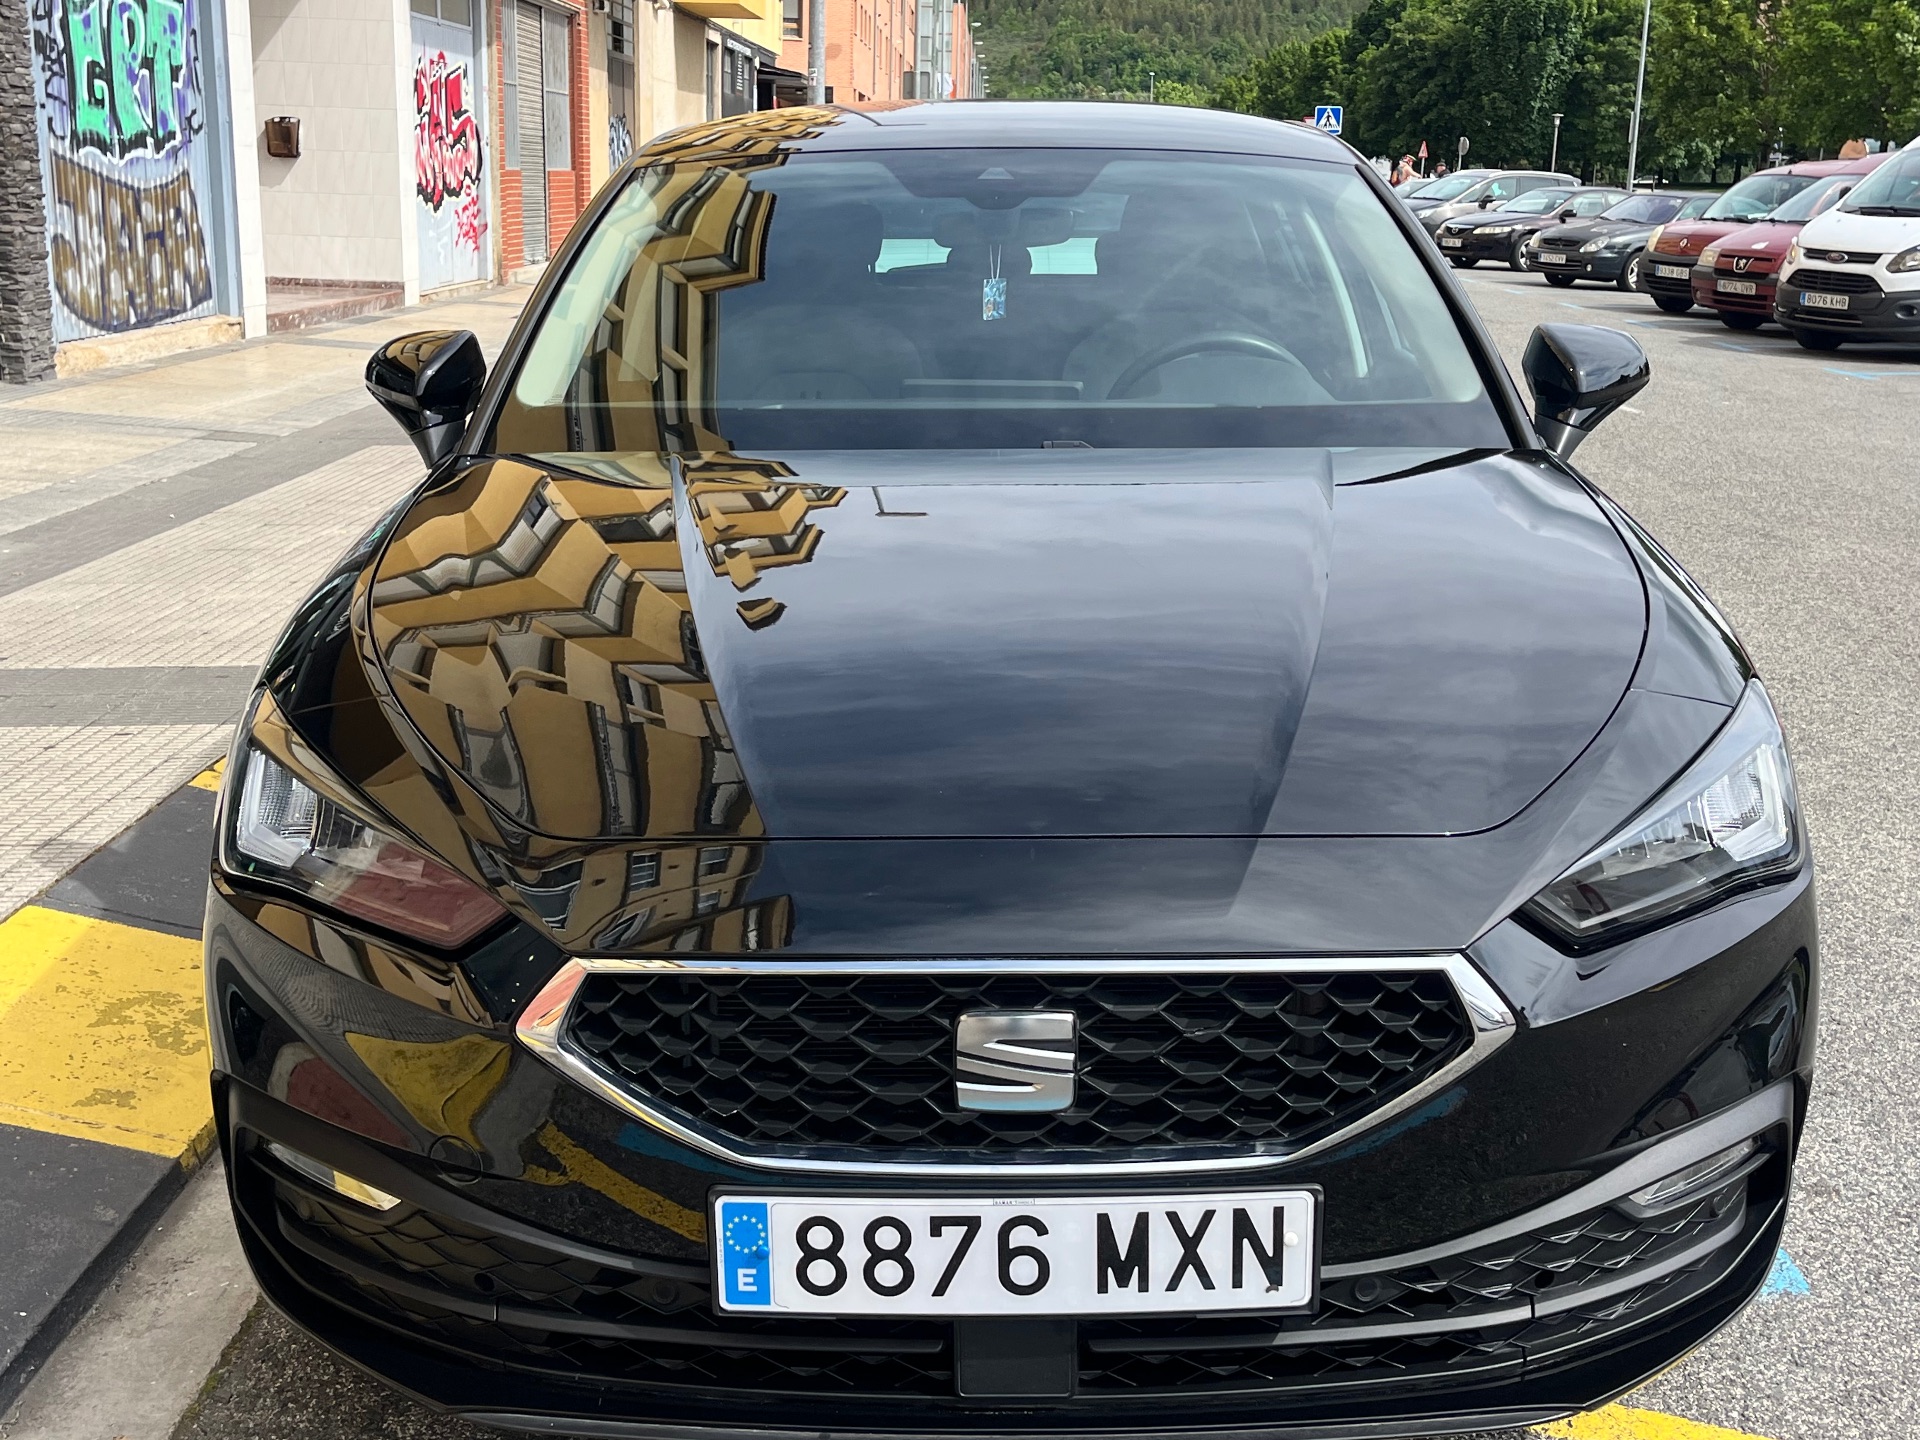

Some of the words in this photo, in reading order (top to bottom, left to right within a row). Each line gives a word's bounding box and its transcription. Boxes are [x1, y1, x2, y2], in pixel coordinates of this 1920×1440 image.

[1806, 293, 1828, 306] 8076
[1829, 295, 1847, 308] KHB
[796, 1214, 1050, 1296] 8876
[1097, 1206, 1285, 1295] MXN
[737, 1268, 758, 1292] E
